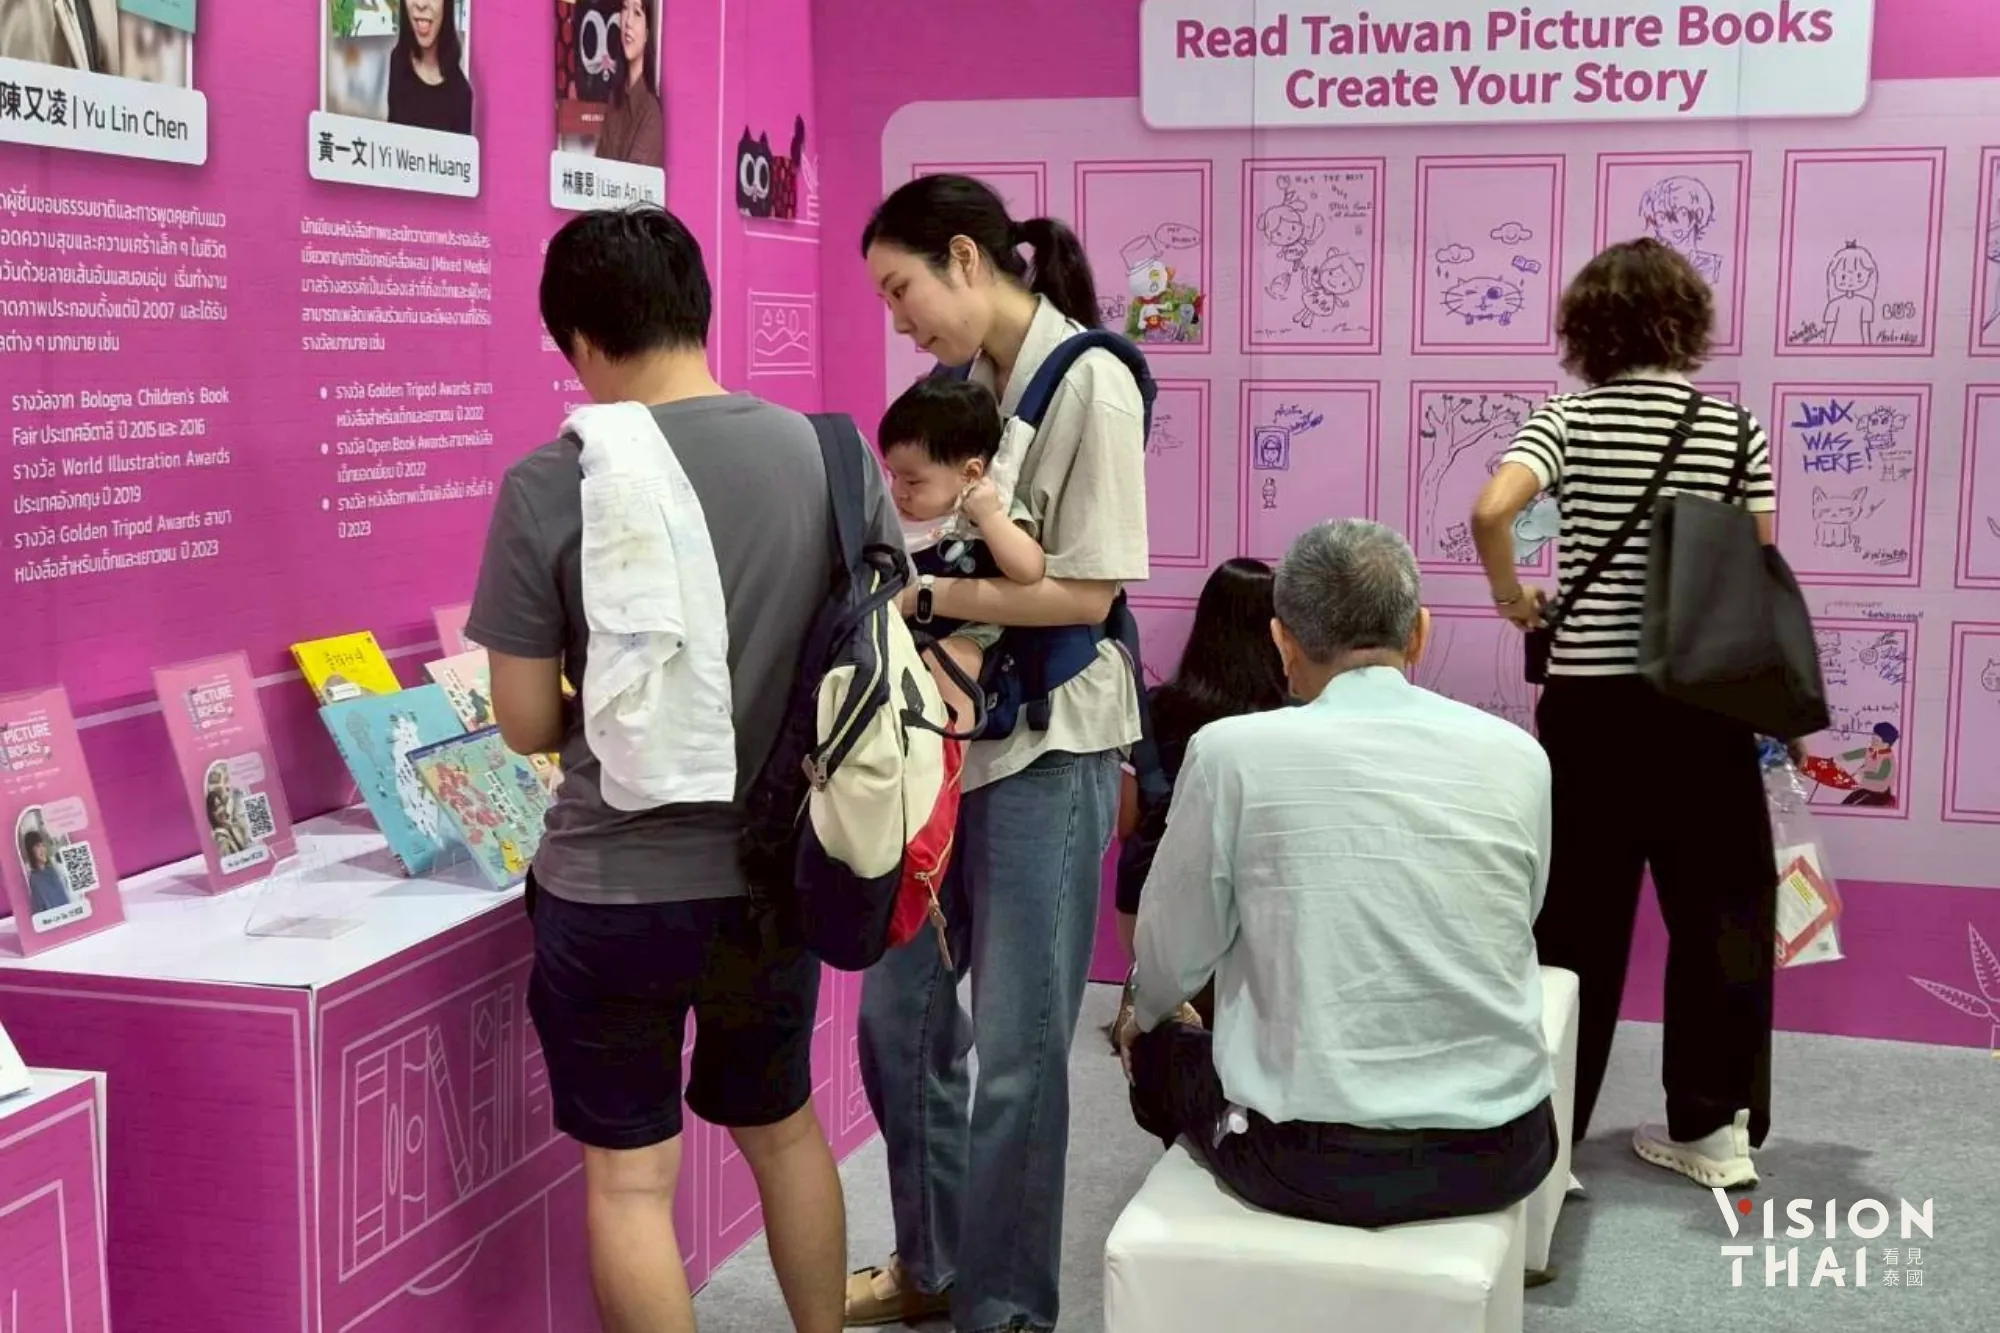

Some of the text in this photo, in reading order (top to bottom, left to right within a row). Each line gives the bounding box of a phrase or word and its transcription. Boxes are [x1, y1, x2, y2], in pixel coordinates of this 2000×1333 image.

[1176, 0, 1833, 59] Read Taiwan Picture Books
[1285, 62, 1708, 112] Create Your Story
[83, 101, 106, 129] Yu
[111, 105, 138, 133] Lin
[143, 111, 188, 141] Chen
[379, 146, 393, 168] Yi
[396, 148, 426, 172] Wen
[429, 153, 471, 183] Huang
[143, 302, 175, 319] 2007
[12, 385, 229, 412] รางวัลจาก Bologna Children's Book
[406, 382, 437, 401] Tripod
[12, 426, 36, 446] Fair
[130, 420, 157, 438] 2015
[180, 418, 206, 436] 2016
[1801, 431, 1852, 451] WAS
[367, 438, 392, 456] Open
[393, 436, 417, 452] Book
[14, 447, 230, 480] รางวัล World Illustration Awards
[114, 485, 142, 505] 2019
[14, 526, 56, 550] รางวัล
[60, 523, 108, 544] Golden
[111, 516, 152, 542] Tripod
[157, 511, 200, 533] Awards
[192, 539, 219, 559] 2023
[4, 721, 52, 744] PICTURE
